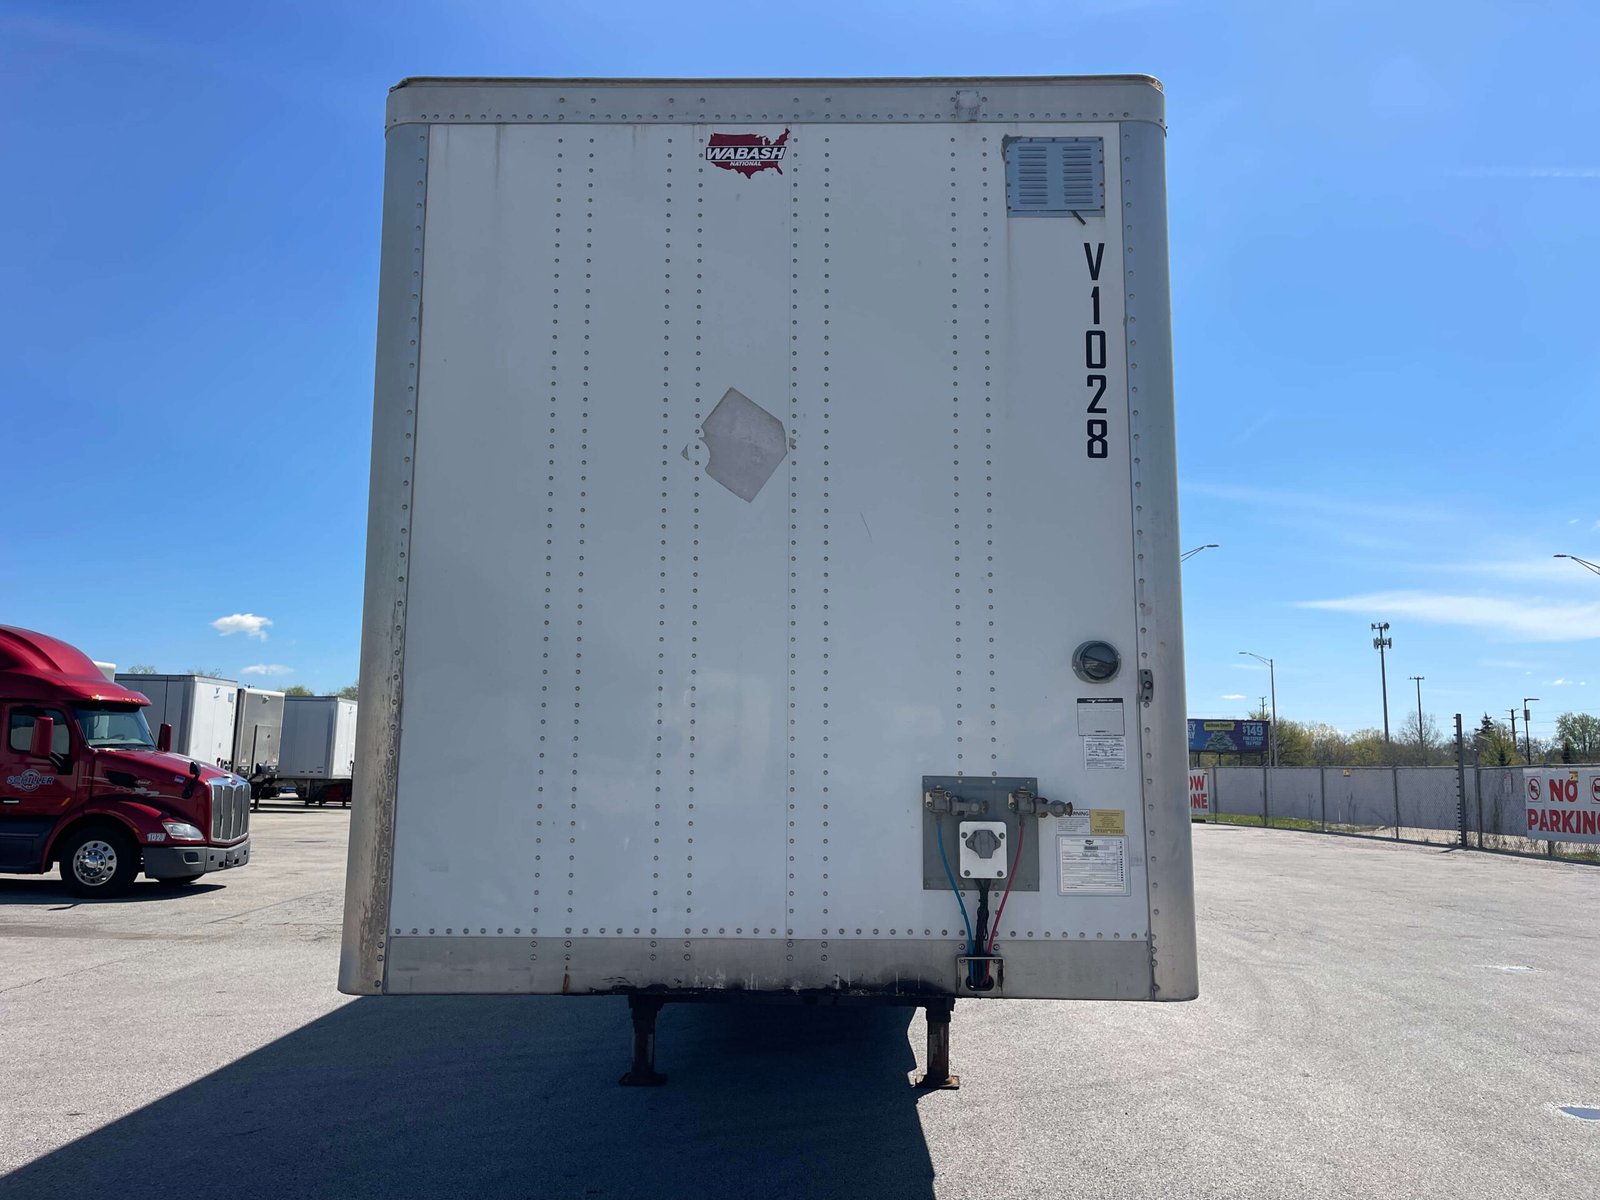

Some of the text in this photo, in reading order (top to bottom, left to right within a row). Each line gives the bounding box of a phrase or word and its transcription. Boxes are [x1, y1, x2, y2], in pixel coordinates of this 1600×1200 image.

[706, 147, 786, 160] WABASH
[1083, 242, 1109, 459] V1028
[1242, 725, 1264, 736] $149
[7, 775, 55, 785] SCHILLER
[1548, 778, 1579, 803] NO
[1527, 808, 1600, 835] PARKIN
